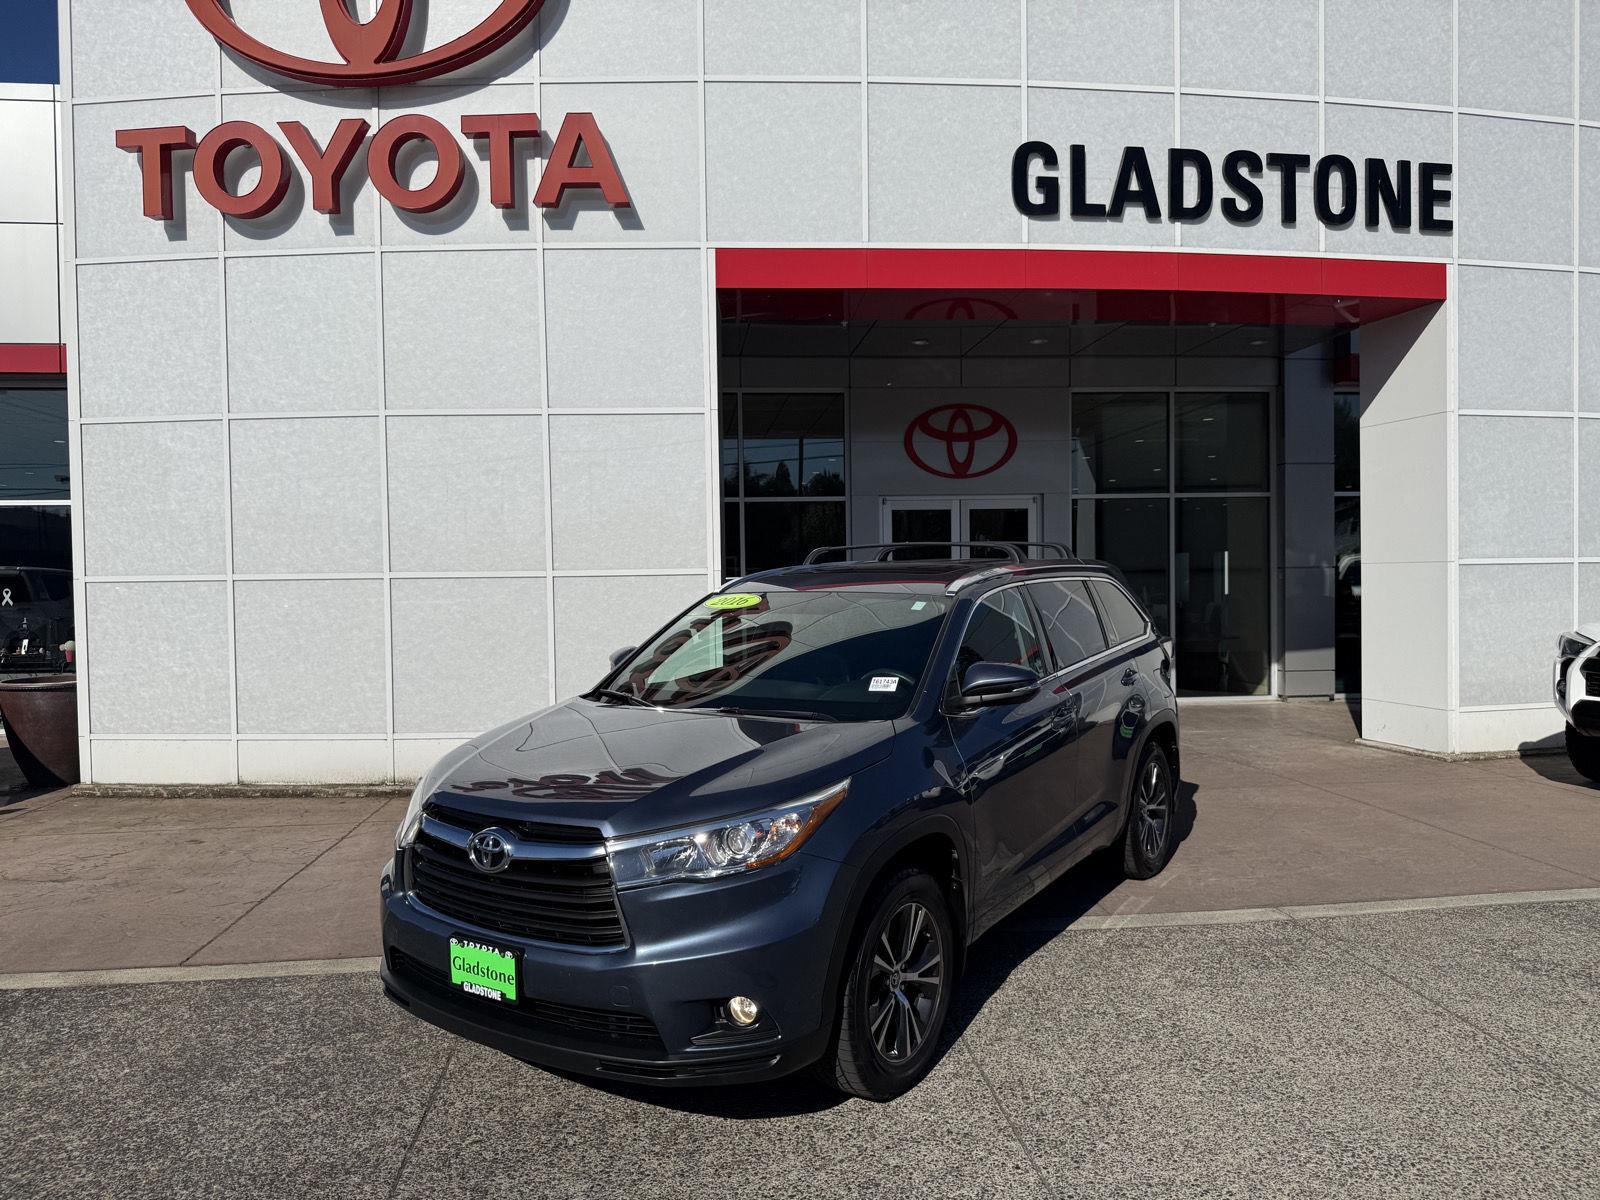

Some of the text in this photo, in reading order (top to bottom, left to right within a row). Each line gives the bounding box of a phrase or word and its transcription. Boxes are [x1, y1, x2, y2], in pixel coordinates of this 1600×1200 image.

[116, 112, 631, 221] TOYOTA
[1011, 140, 1454, 232] GLADSTONE
[709, 596, 755, 606] 2016
[463, 940, 500, 956] TOYOTA
[452, 955, 515, 986] Gladstone
[463, 981, 502, 1001] GLADSTONE
